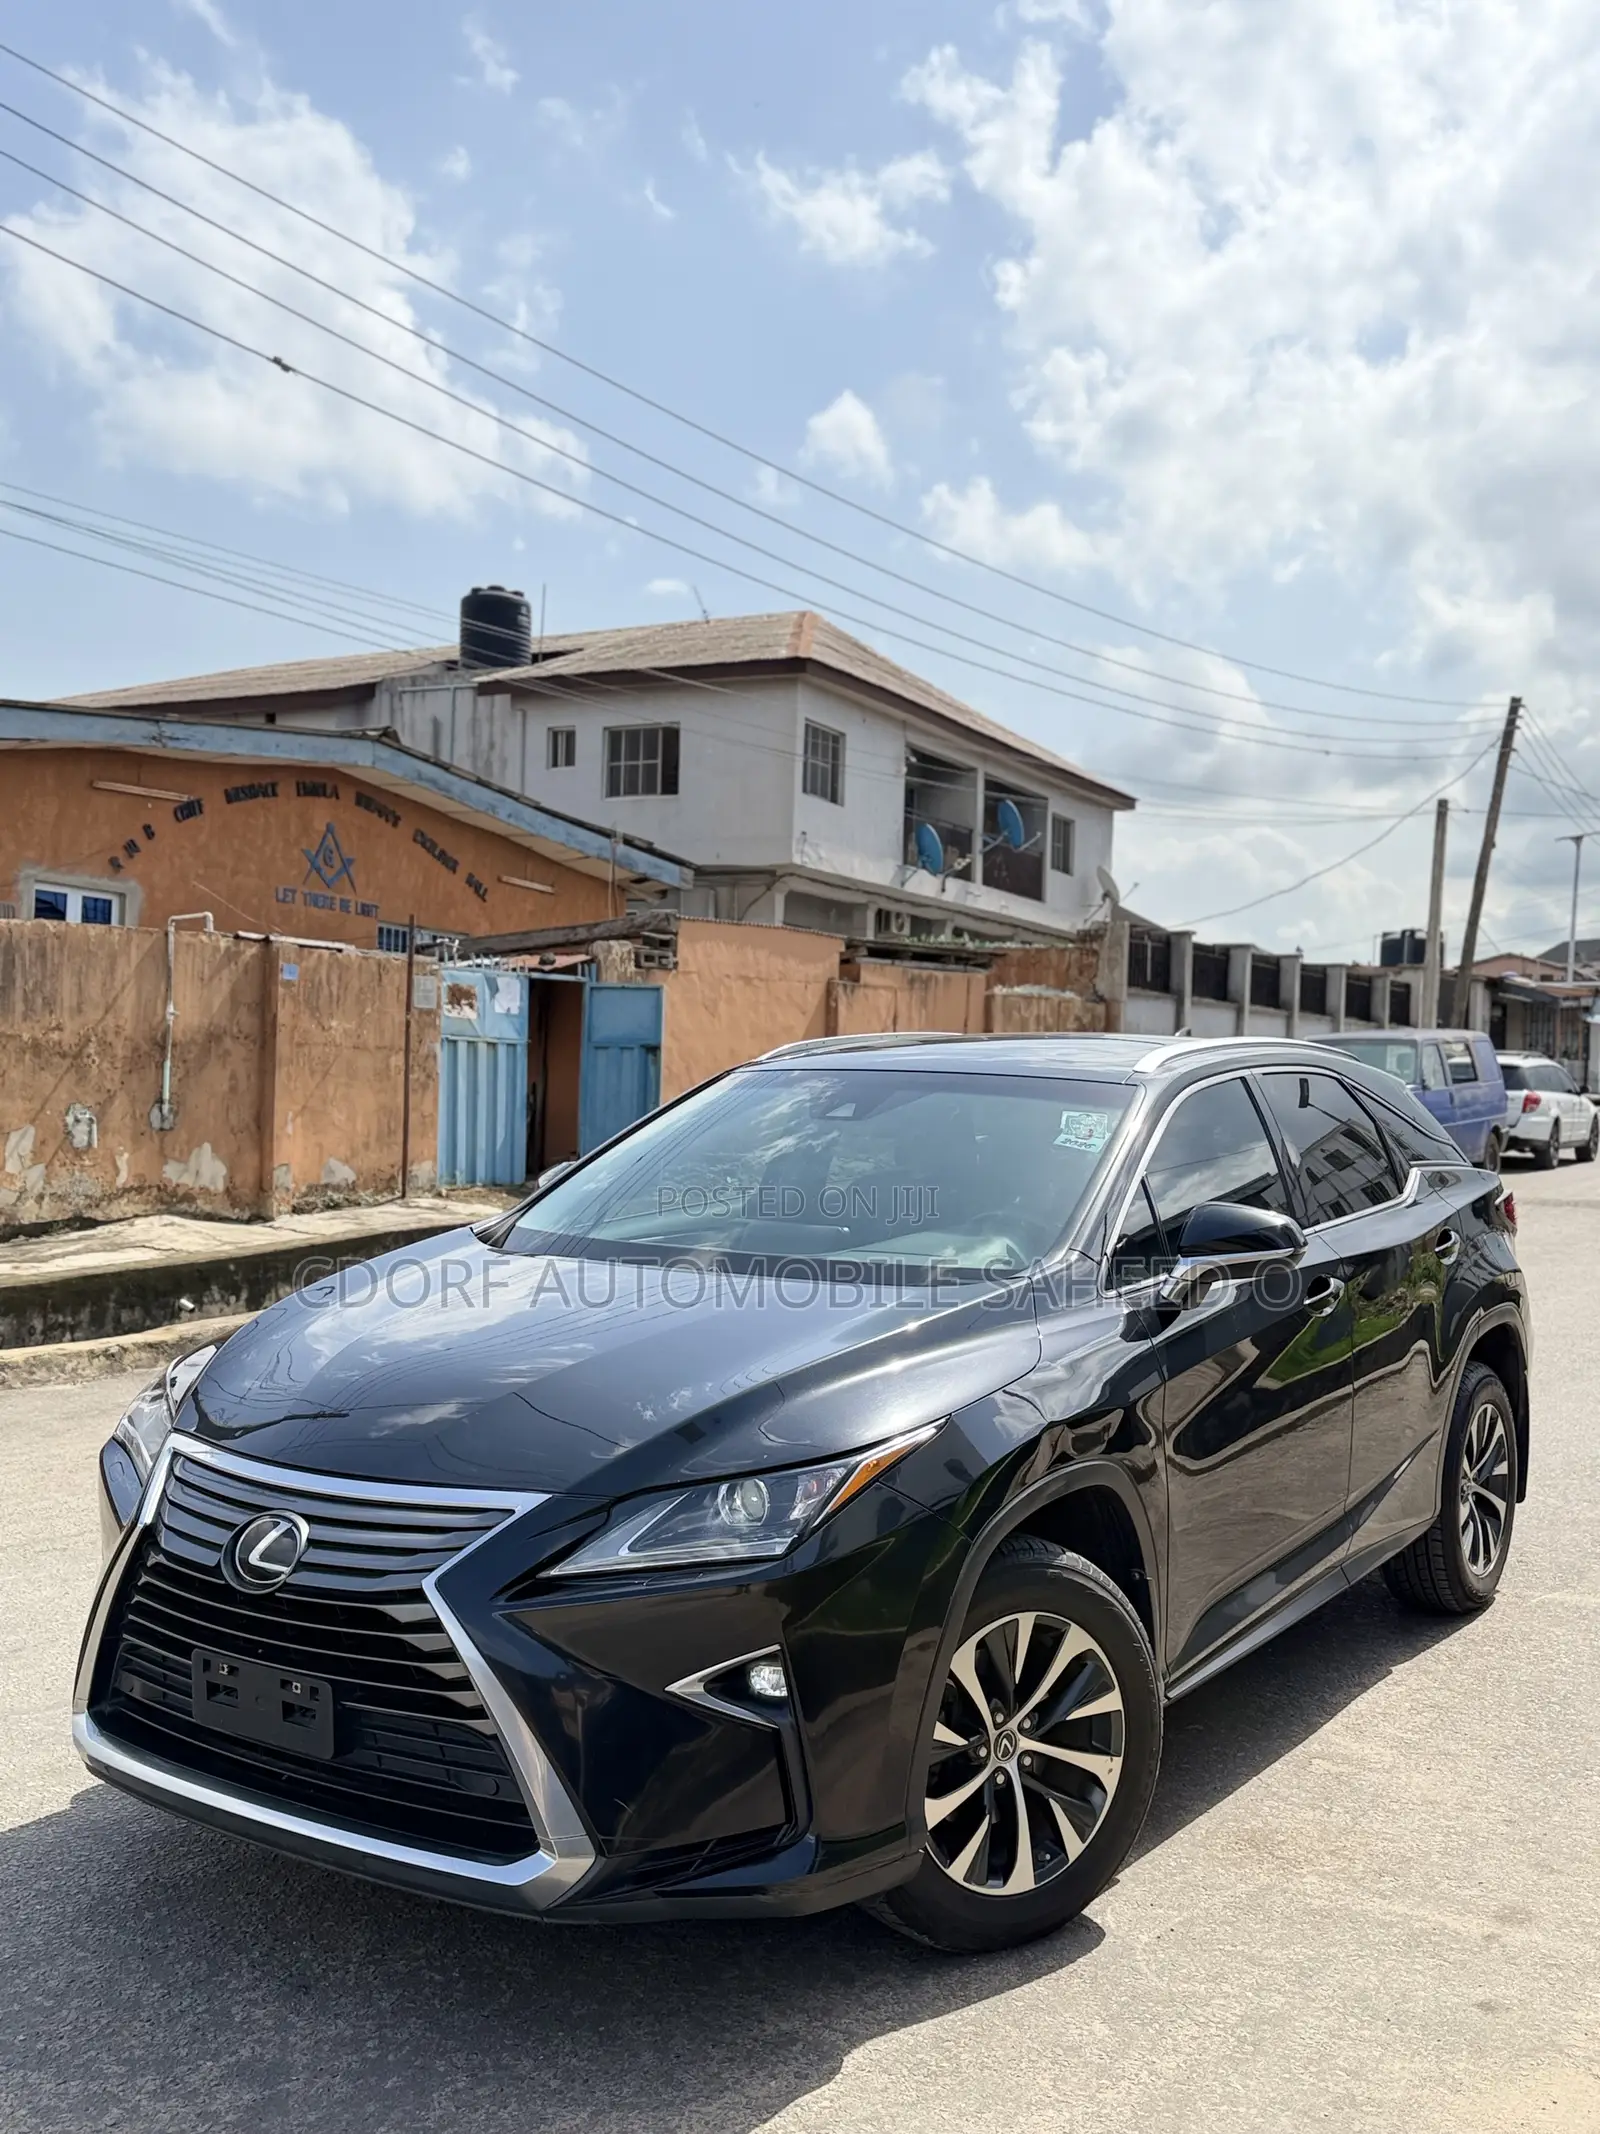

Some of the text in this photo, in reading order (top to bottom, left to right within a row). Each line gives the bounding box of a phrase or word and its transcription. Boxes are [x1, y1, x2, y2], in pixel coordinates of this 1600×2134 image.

[275, 886, 297, 904] LET
[301, 891, 336, 911] THERE
[355, 900, 379, 918] LIGHT
